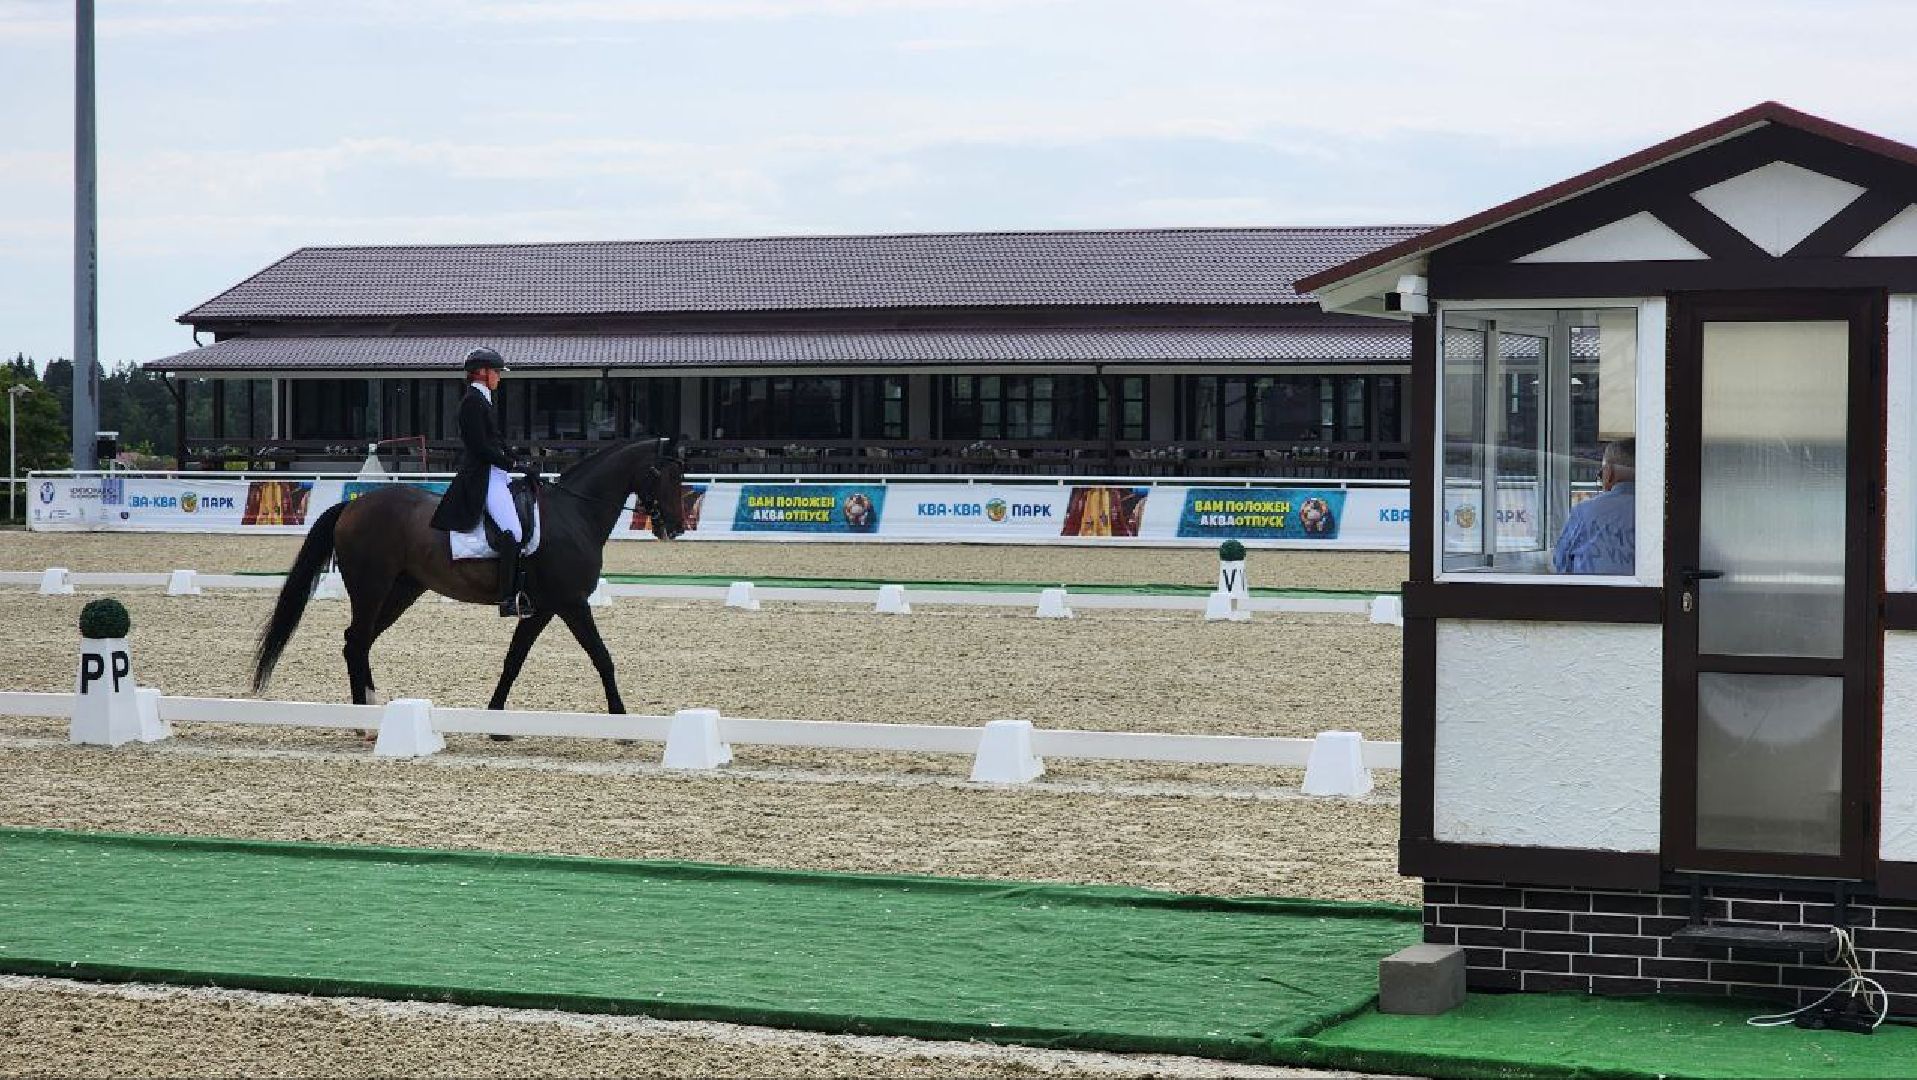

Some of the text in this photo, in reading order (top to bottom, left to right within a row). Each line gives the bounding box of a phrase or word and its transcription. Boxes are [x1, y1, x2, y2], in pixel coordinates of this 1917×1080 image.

[201, 497, 234, 509] ПАРК
[748, 496, 836, 508] ВАМ ПОЛОЖЕН
[1194, 500, 1291, 514] ВАМ ПОЛОЖЕН
[1011, 503, 1052, 517] ПАРК
[1496, 509, 1527, 523] АРК
[1222, 569, 1238, 594] V
